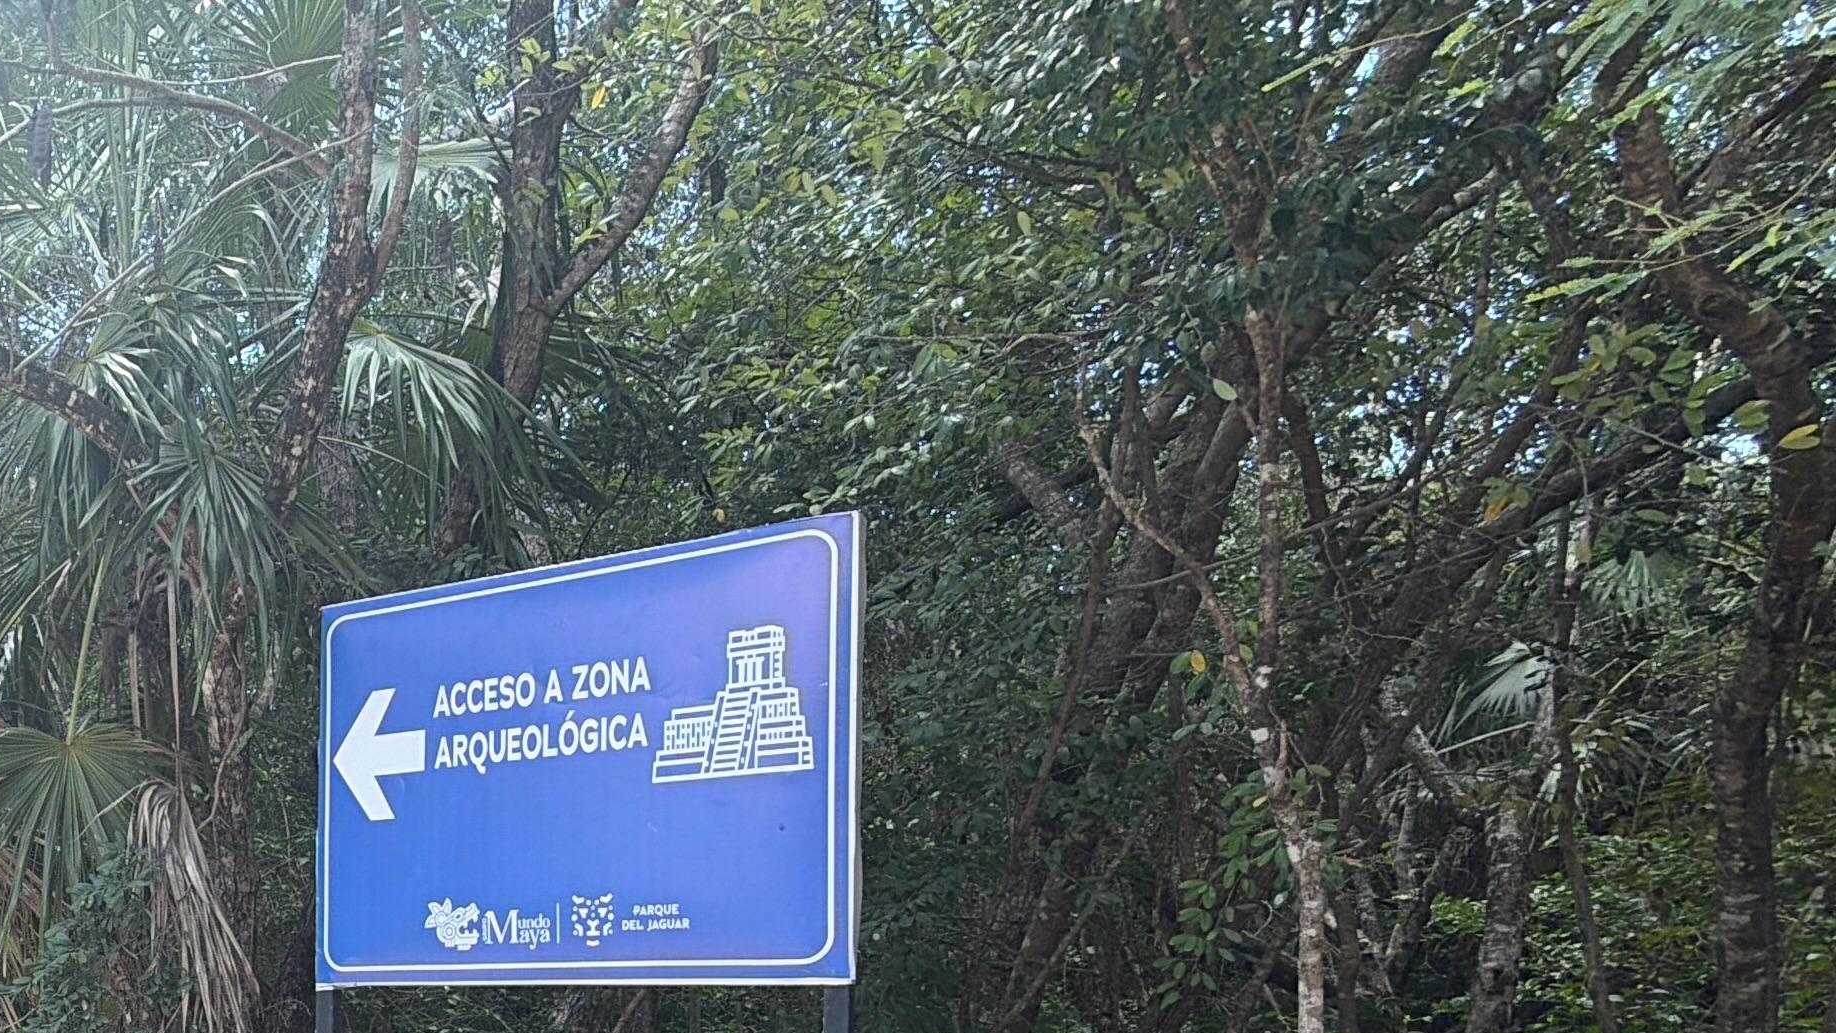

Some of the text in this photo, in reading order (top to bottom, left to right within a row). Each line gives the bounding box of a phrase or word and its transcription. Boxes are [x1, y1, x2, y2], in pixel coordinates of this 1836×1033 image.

[432, 656, 651, 718] ACCESO A ZONA
[434, 710, 648, 775] ARQUEOLÓGICA
[622, 918, 689, 931] DEL JAGUAR
[633, 904, 679, 916] PARQUE
